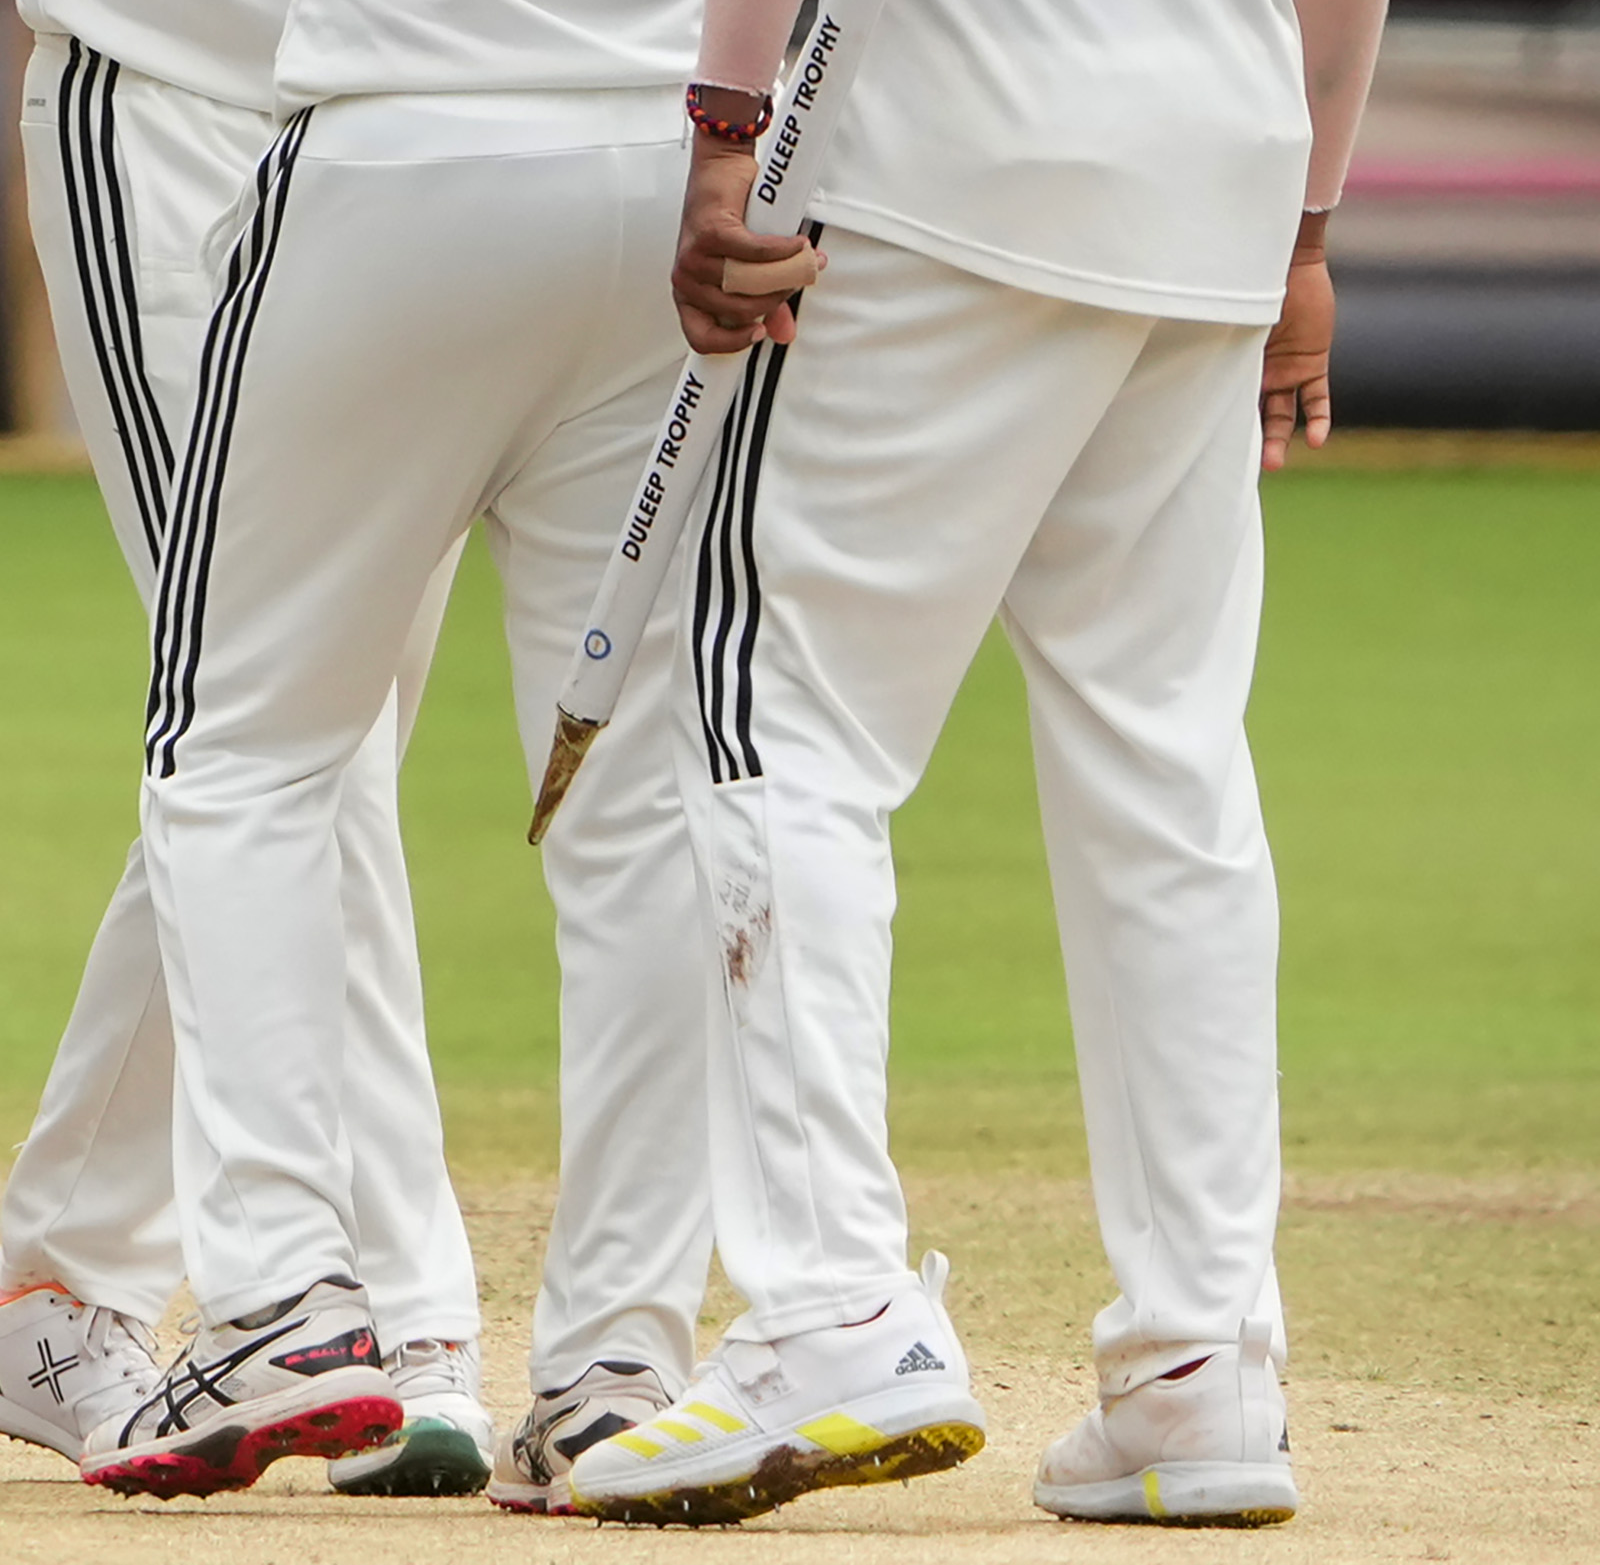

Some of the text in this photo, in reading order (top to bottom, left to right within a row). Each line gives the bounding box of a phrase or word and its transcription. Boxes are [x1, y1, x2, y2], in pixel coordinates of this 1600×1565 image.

[757, 13, 842, 205] DULEEP TROPHY
[621, 371, 705, 563] DULEEP TROPHY
[895, 1358, 946, 1376] adidas
